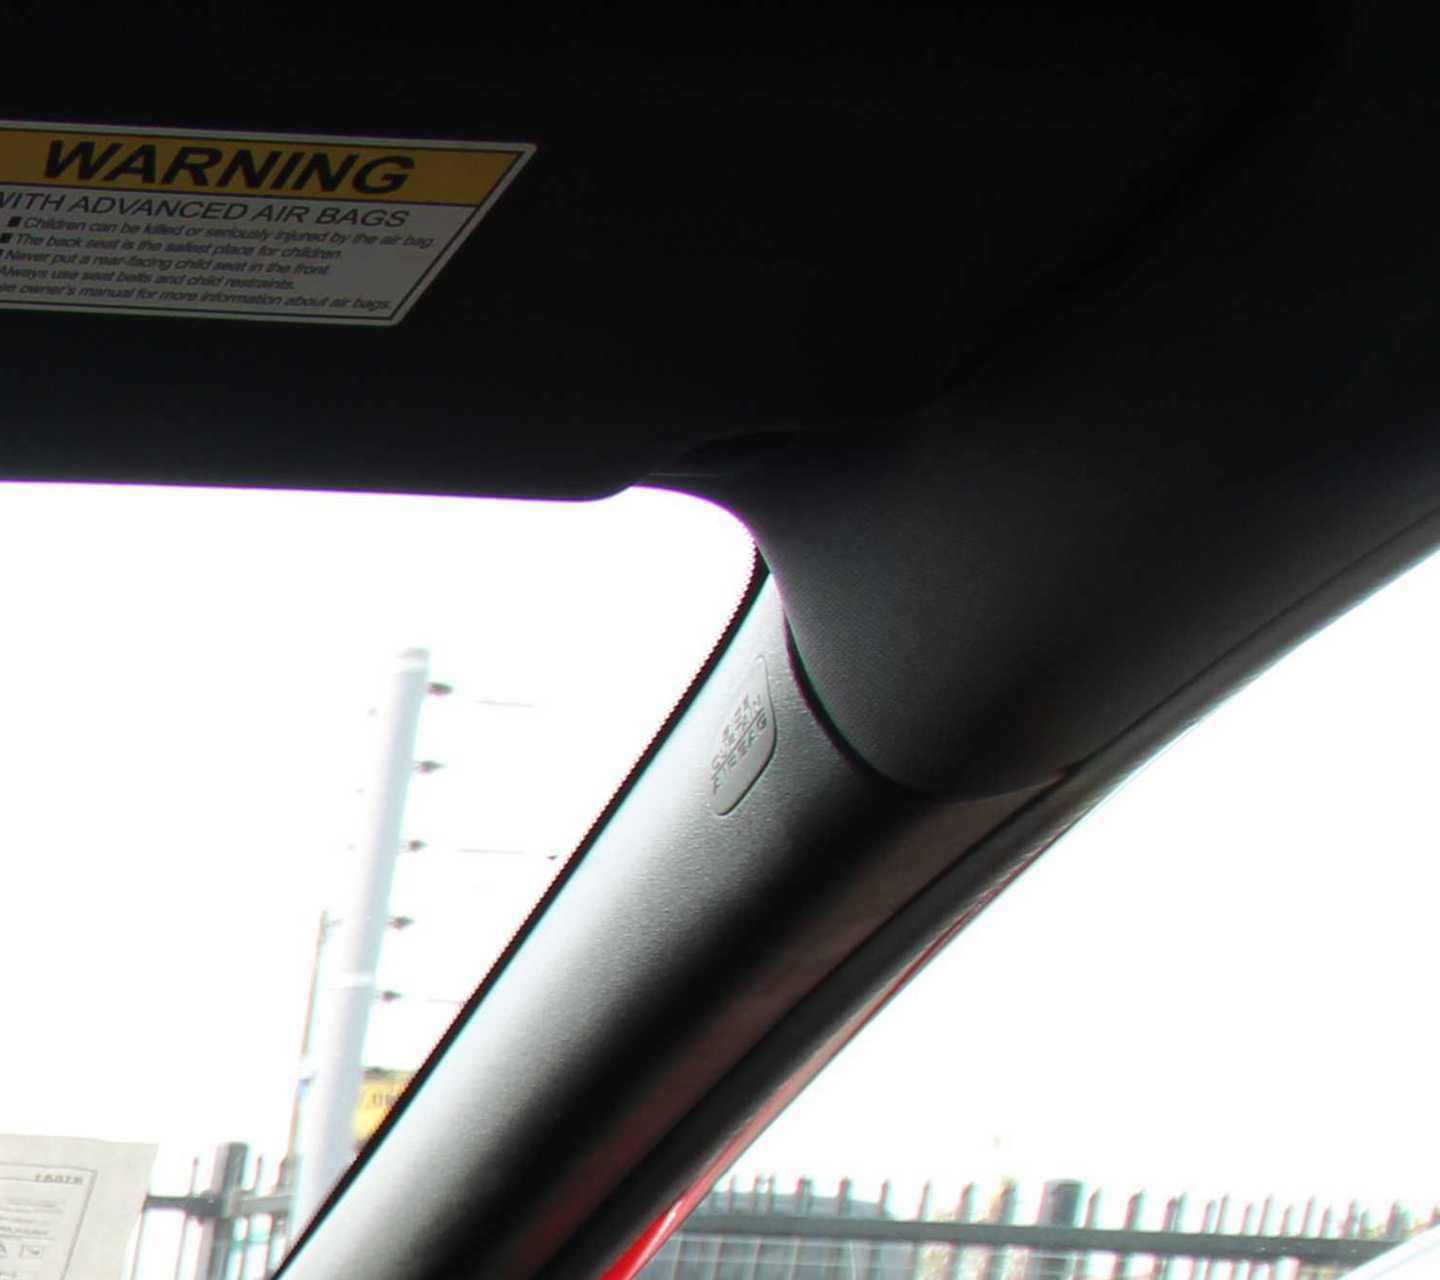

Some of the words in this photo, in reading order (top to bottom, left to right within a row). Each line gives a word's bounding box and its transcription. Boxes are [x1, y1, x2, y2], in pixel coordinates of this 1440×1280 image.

[45, 139, 415, 193] WARNING
[68, 195, 246, 221] ADVANCED
[252, 204, 310, 223] AIR
[316, 207, 410, 227] BAGS
